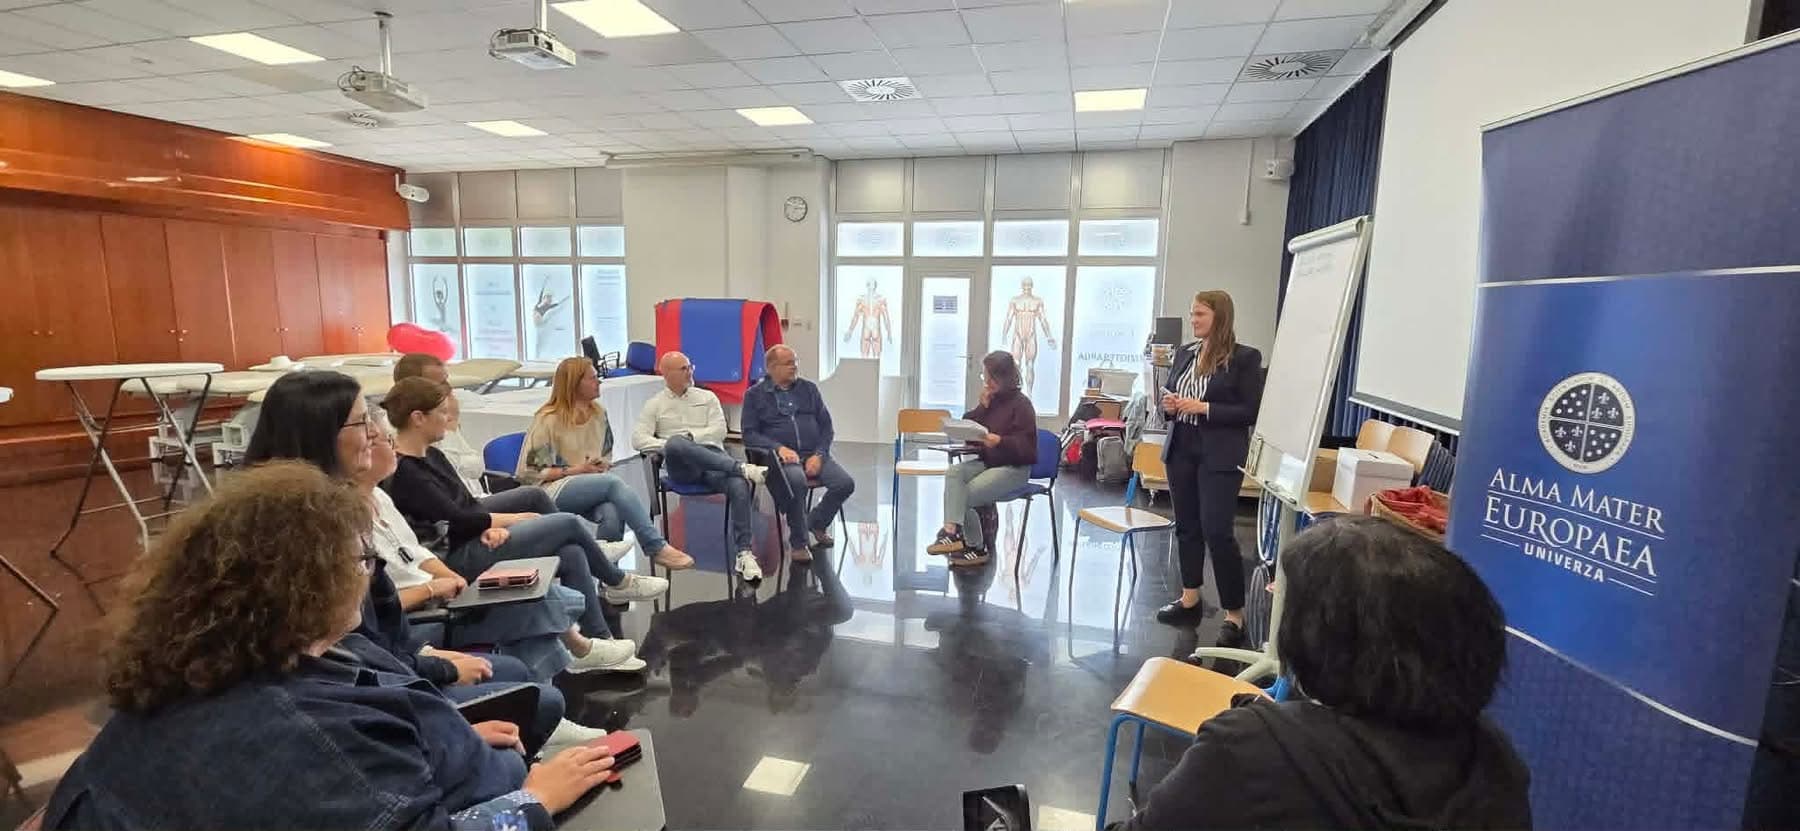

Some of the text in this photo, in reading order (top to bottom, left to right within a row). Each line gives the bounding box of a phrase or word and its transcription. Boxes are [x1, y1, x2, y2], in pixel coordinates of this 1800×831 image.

[1489, 467, 1665, 534] ALMA MATER
[1484, 495, 1657, 577] EUROPAEA
[1523, 542, 1604, 583] UNIVERZA
